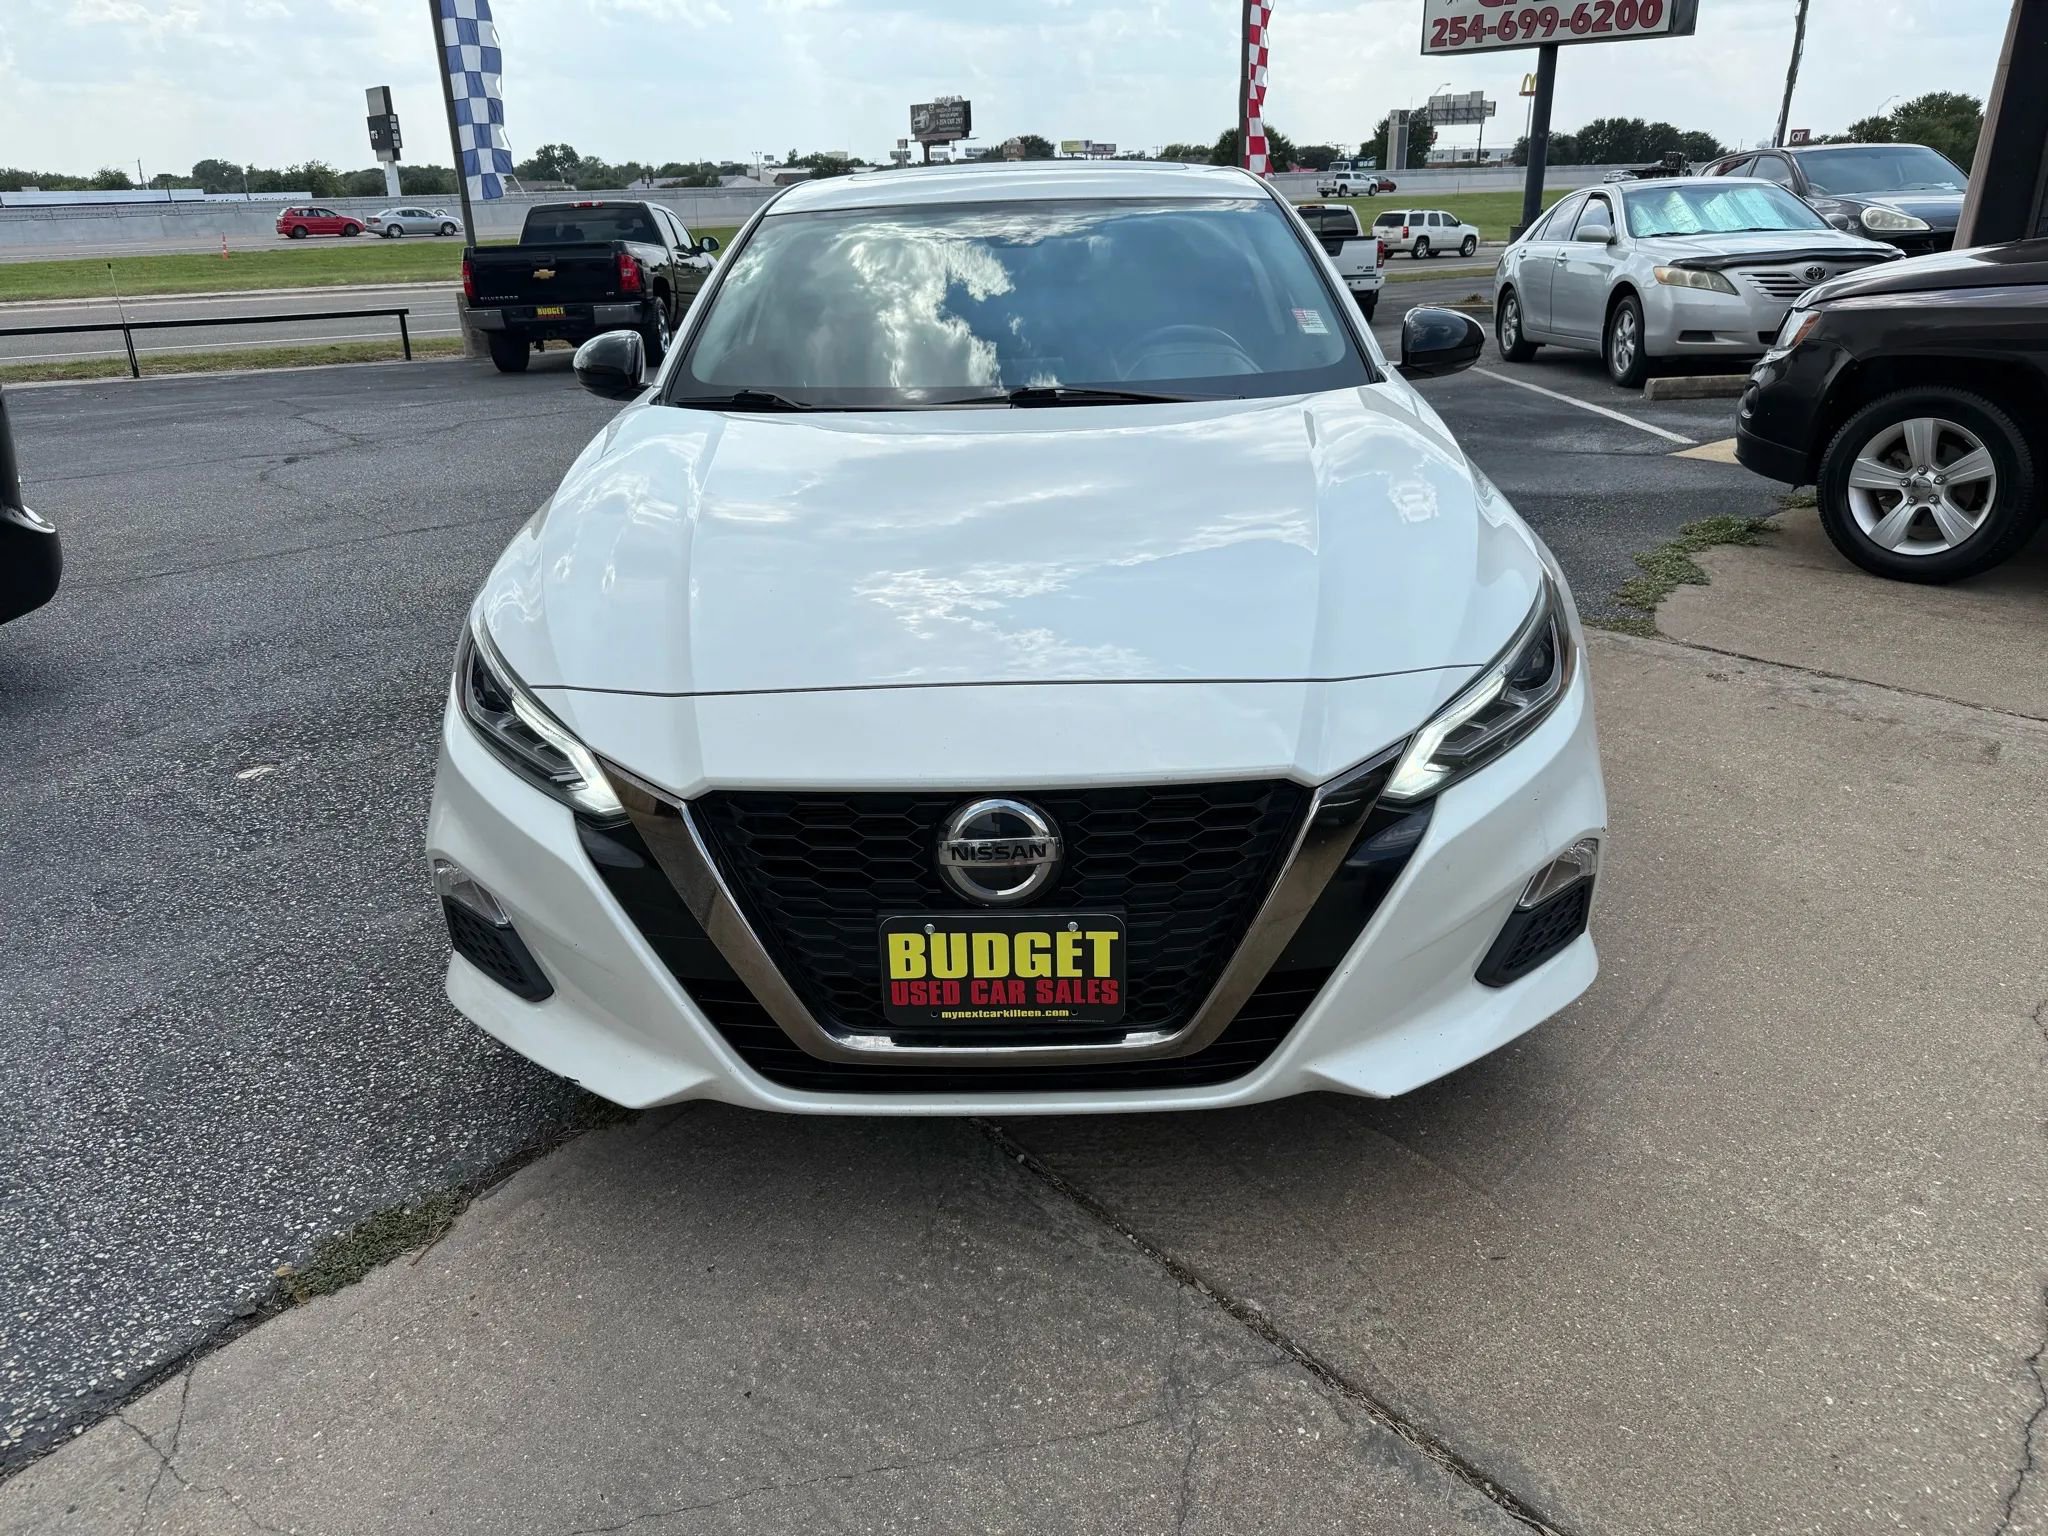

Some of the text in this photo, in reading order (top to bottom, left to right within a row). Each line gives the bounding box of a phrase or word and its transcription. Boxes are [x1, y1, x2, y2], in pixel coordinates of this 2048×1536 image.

[1429, 0, 1663, 47] 254-699-6200
[1791, 131, 1806, 142] QT
[537, 307, 564, 315] BUDGET
[951, 843, 1047, 861] NISSAN
[887, 931, 1119, 979] BUDGET
[890, 980, 1119, 1006] USED CAR SALES
[940, 1009, 1069, 1020] mynextcarkilleen.com
